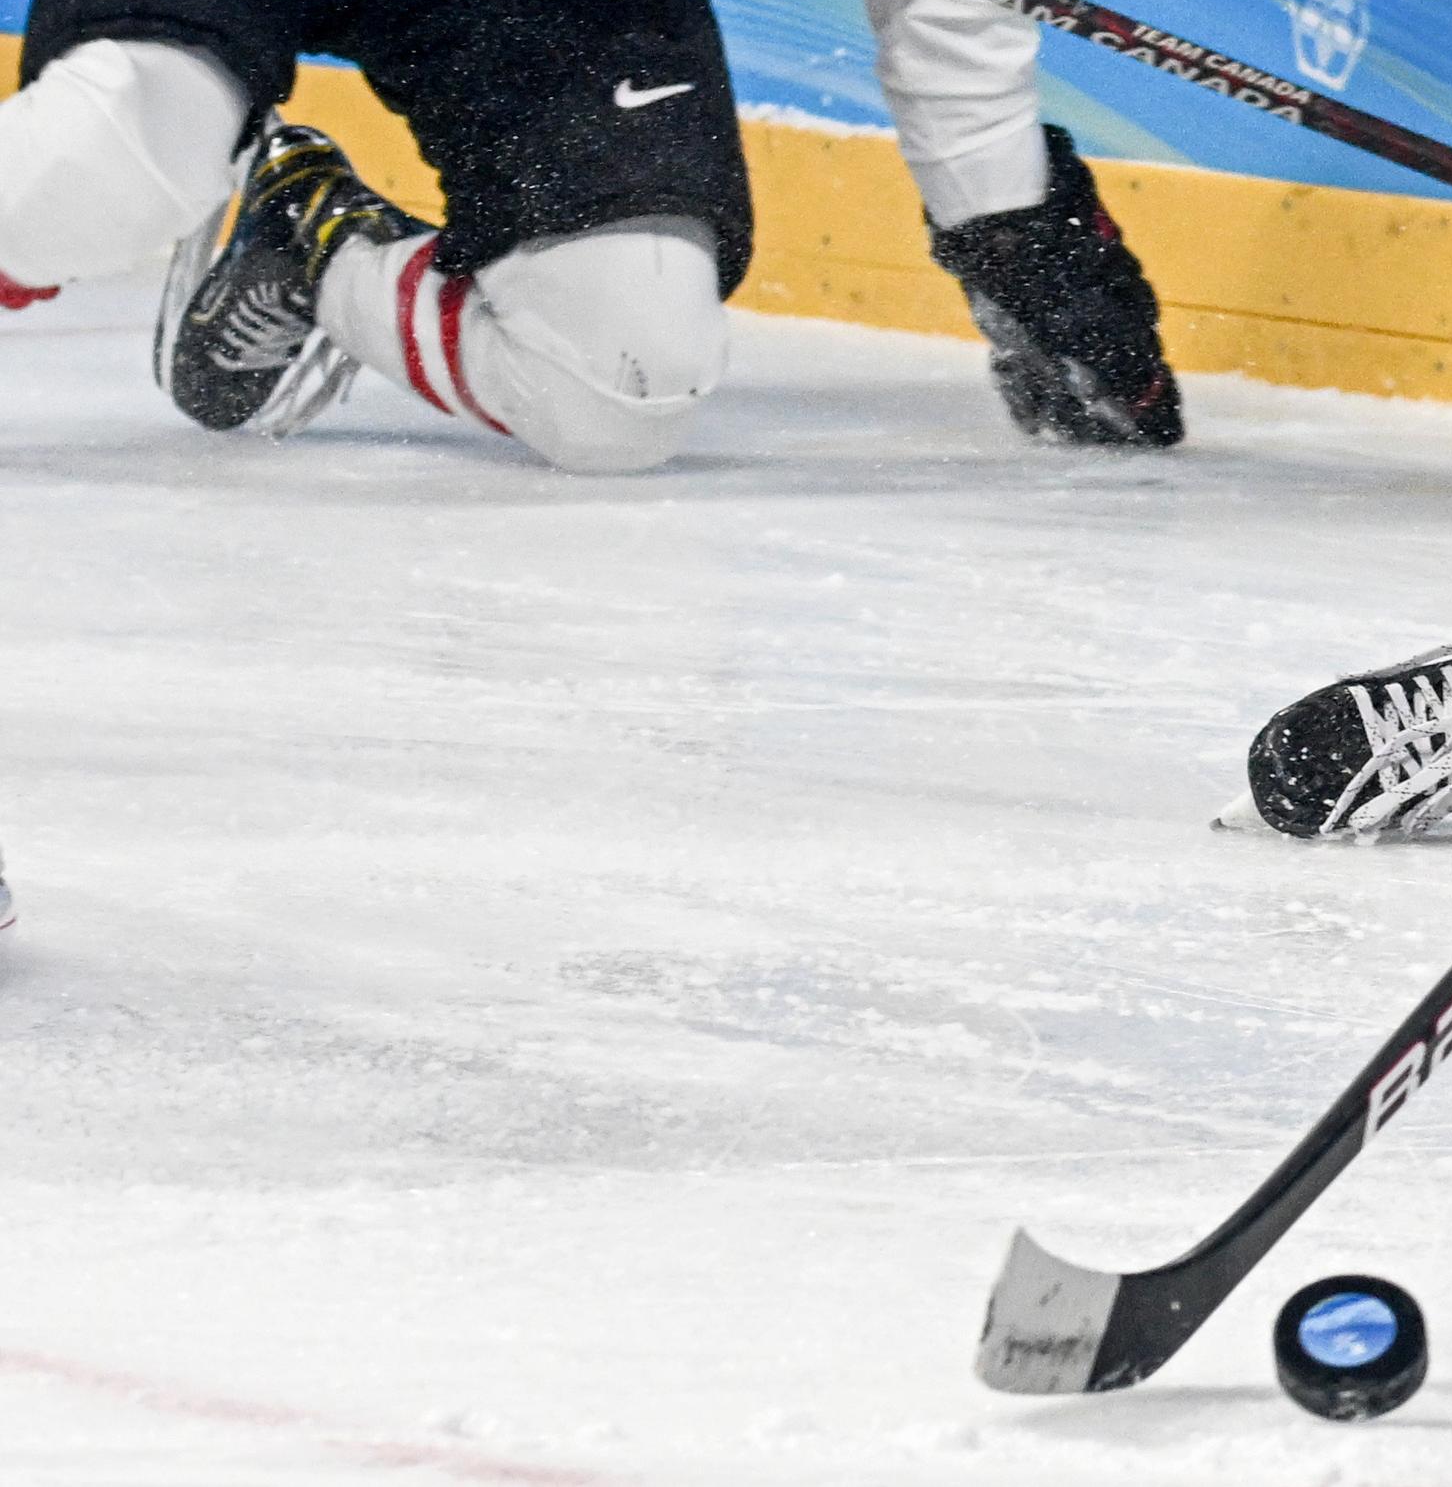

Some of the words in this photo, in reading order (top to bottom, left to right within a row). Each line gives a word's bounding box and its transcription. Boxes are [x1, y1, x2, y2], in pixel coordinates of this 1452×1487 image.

[1090, 30, 1301, 124] CANADA
[1132, 23, 1205, 60] TEAM
[1204, 53, 1311, 104] CANADA
